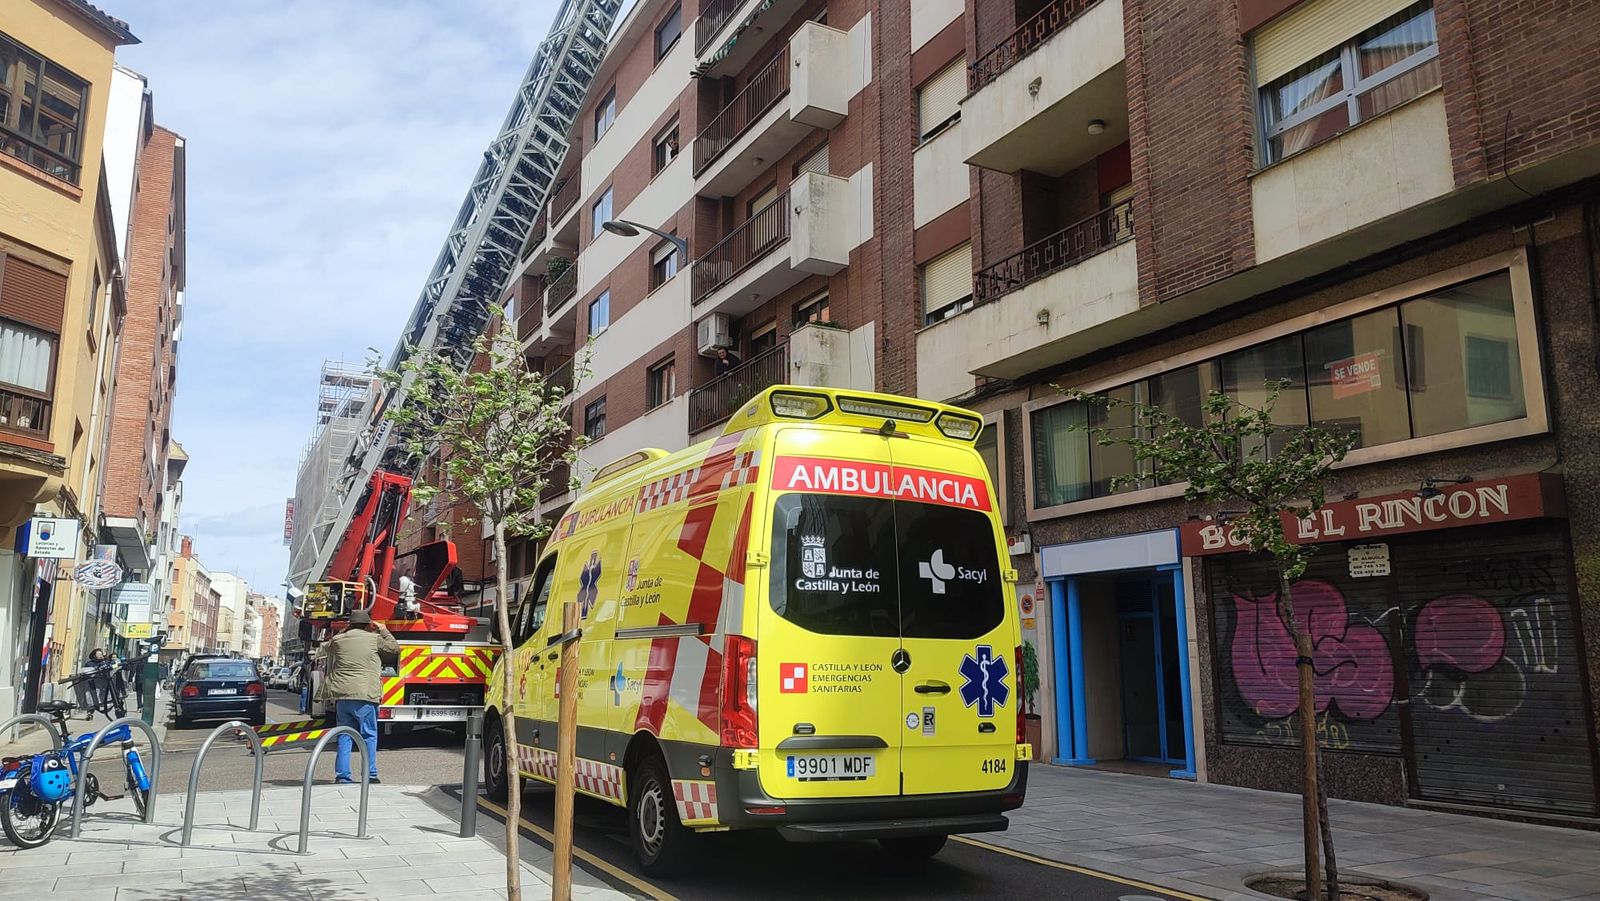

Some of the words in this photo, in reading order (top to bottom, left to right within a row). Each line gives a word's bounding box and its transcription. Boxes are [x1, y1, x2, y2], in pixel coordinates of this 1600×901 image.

[1334, 367, 1345, 380] SE
[1347, 359, 1376, 376] VENDE
[788, 464, 979, 507] AMBULANCIA
[577, 495, 634, 528] AMBULANCIA
[1296, 509, 1346, 539] EL
[1356, 484, 1509, 532] RINCON
[829, 566, 862, 578] Junta
[865, 568, 880, 579] de
[958, 566, 987, 584] Sacyl
[637, 579, 653, 590] Junta
[654, 576, 663, 587] de
[796, 579, 839, 591] Castilla
[841, 582, 849, 594] y
[852, 580, 880, 592] León
[620, 595, 640, 607] Castilla
[645, 591, 661, 604] León
[812, 663, 851, 671] CASTILLA
[812, 674, 872, 682] EMERGENCIAS
[812, 685, 862, 693] SANITARIAS
[798, 758, 837, 774] 9901
[843, 757, 871, 773] MDF
[981, 759, 1006, 774] 4184
